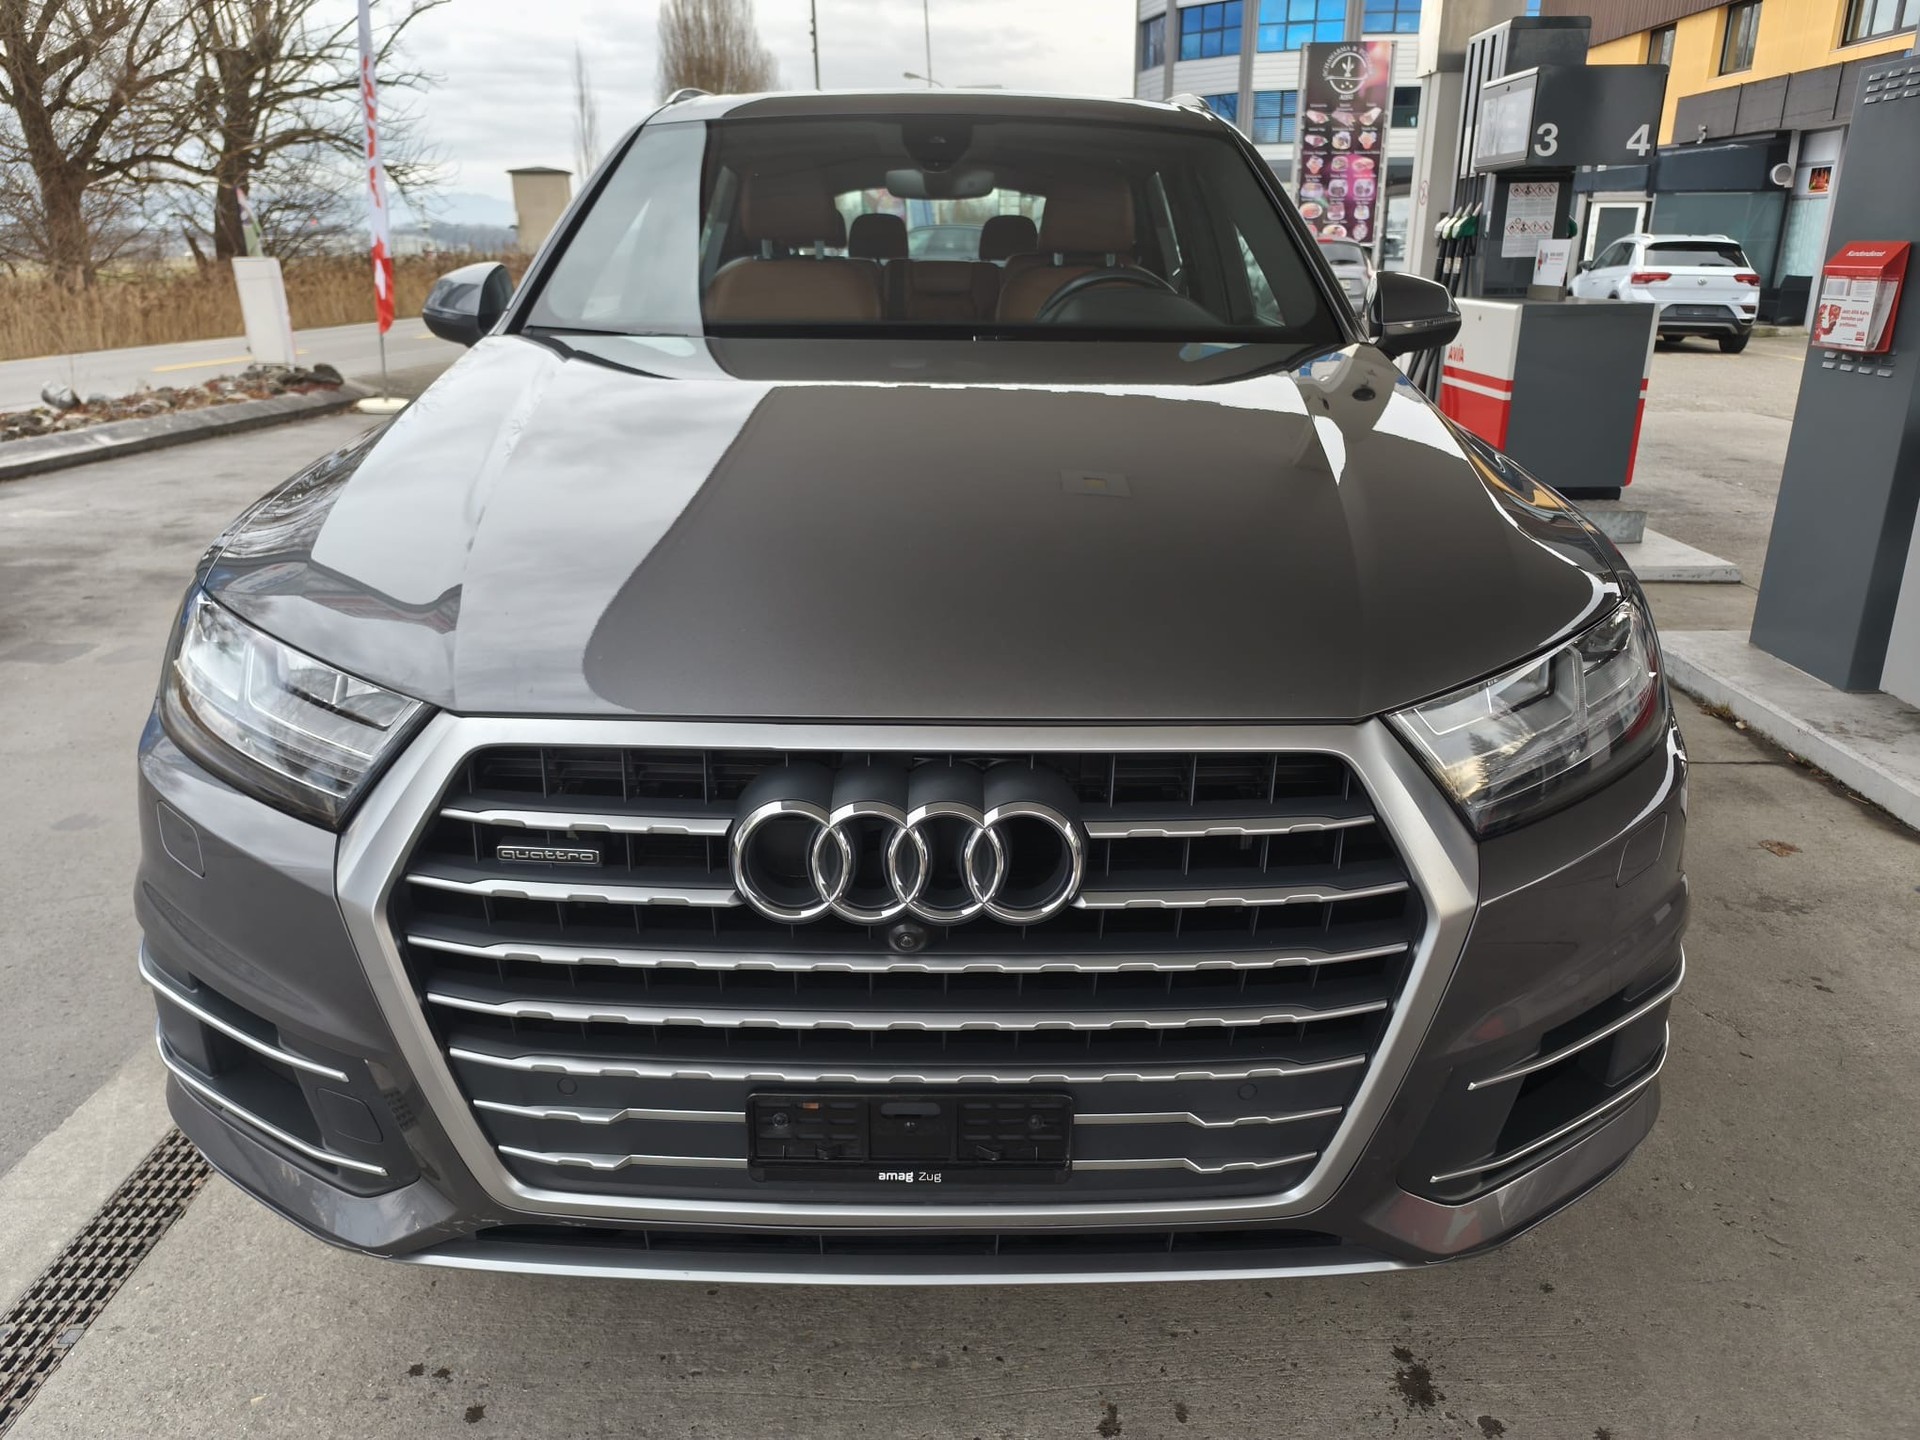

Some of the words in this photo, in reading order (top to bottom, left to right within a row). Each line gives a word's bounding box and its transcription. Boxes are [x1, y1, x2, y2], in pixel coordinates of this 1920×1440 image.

[1534, 123, 1559, 157] 3
[1626, 123, 1651, 157] 4
[501, 850, 594, 861] quattro
[878, 1171, 914, 1183] amag
[918, 1171, 942, 1183] Zug
